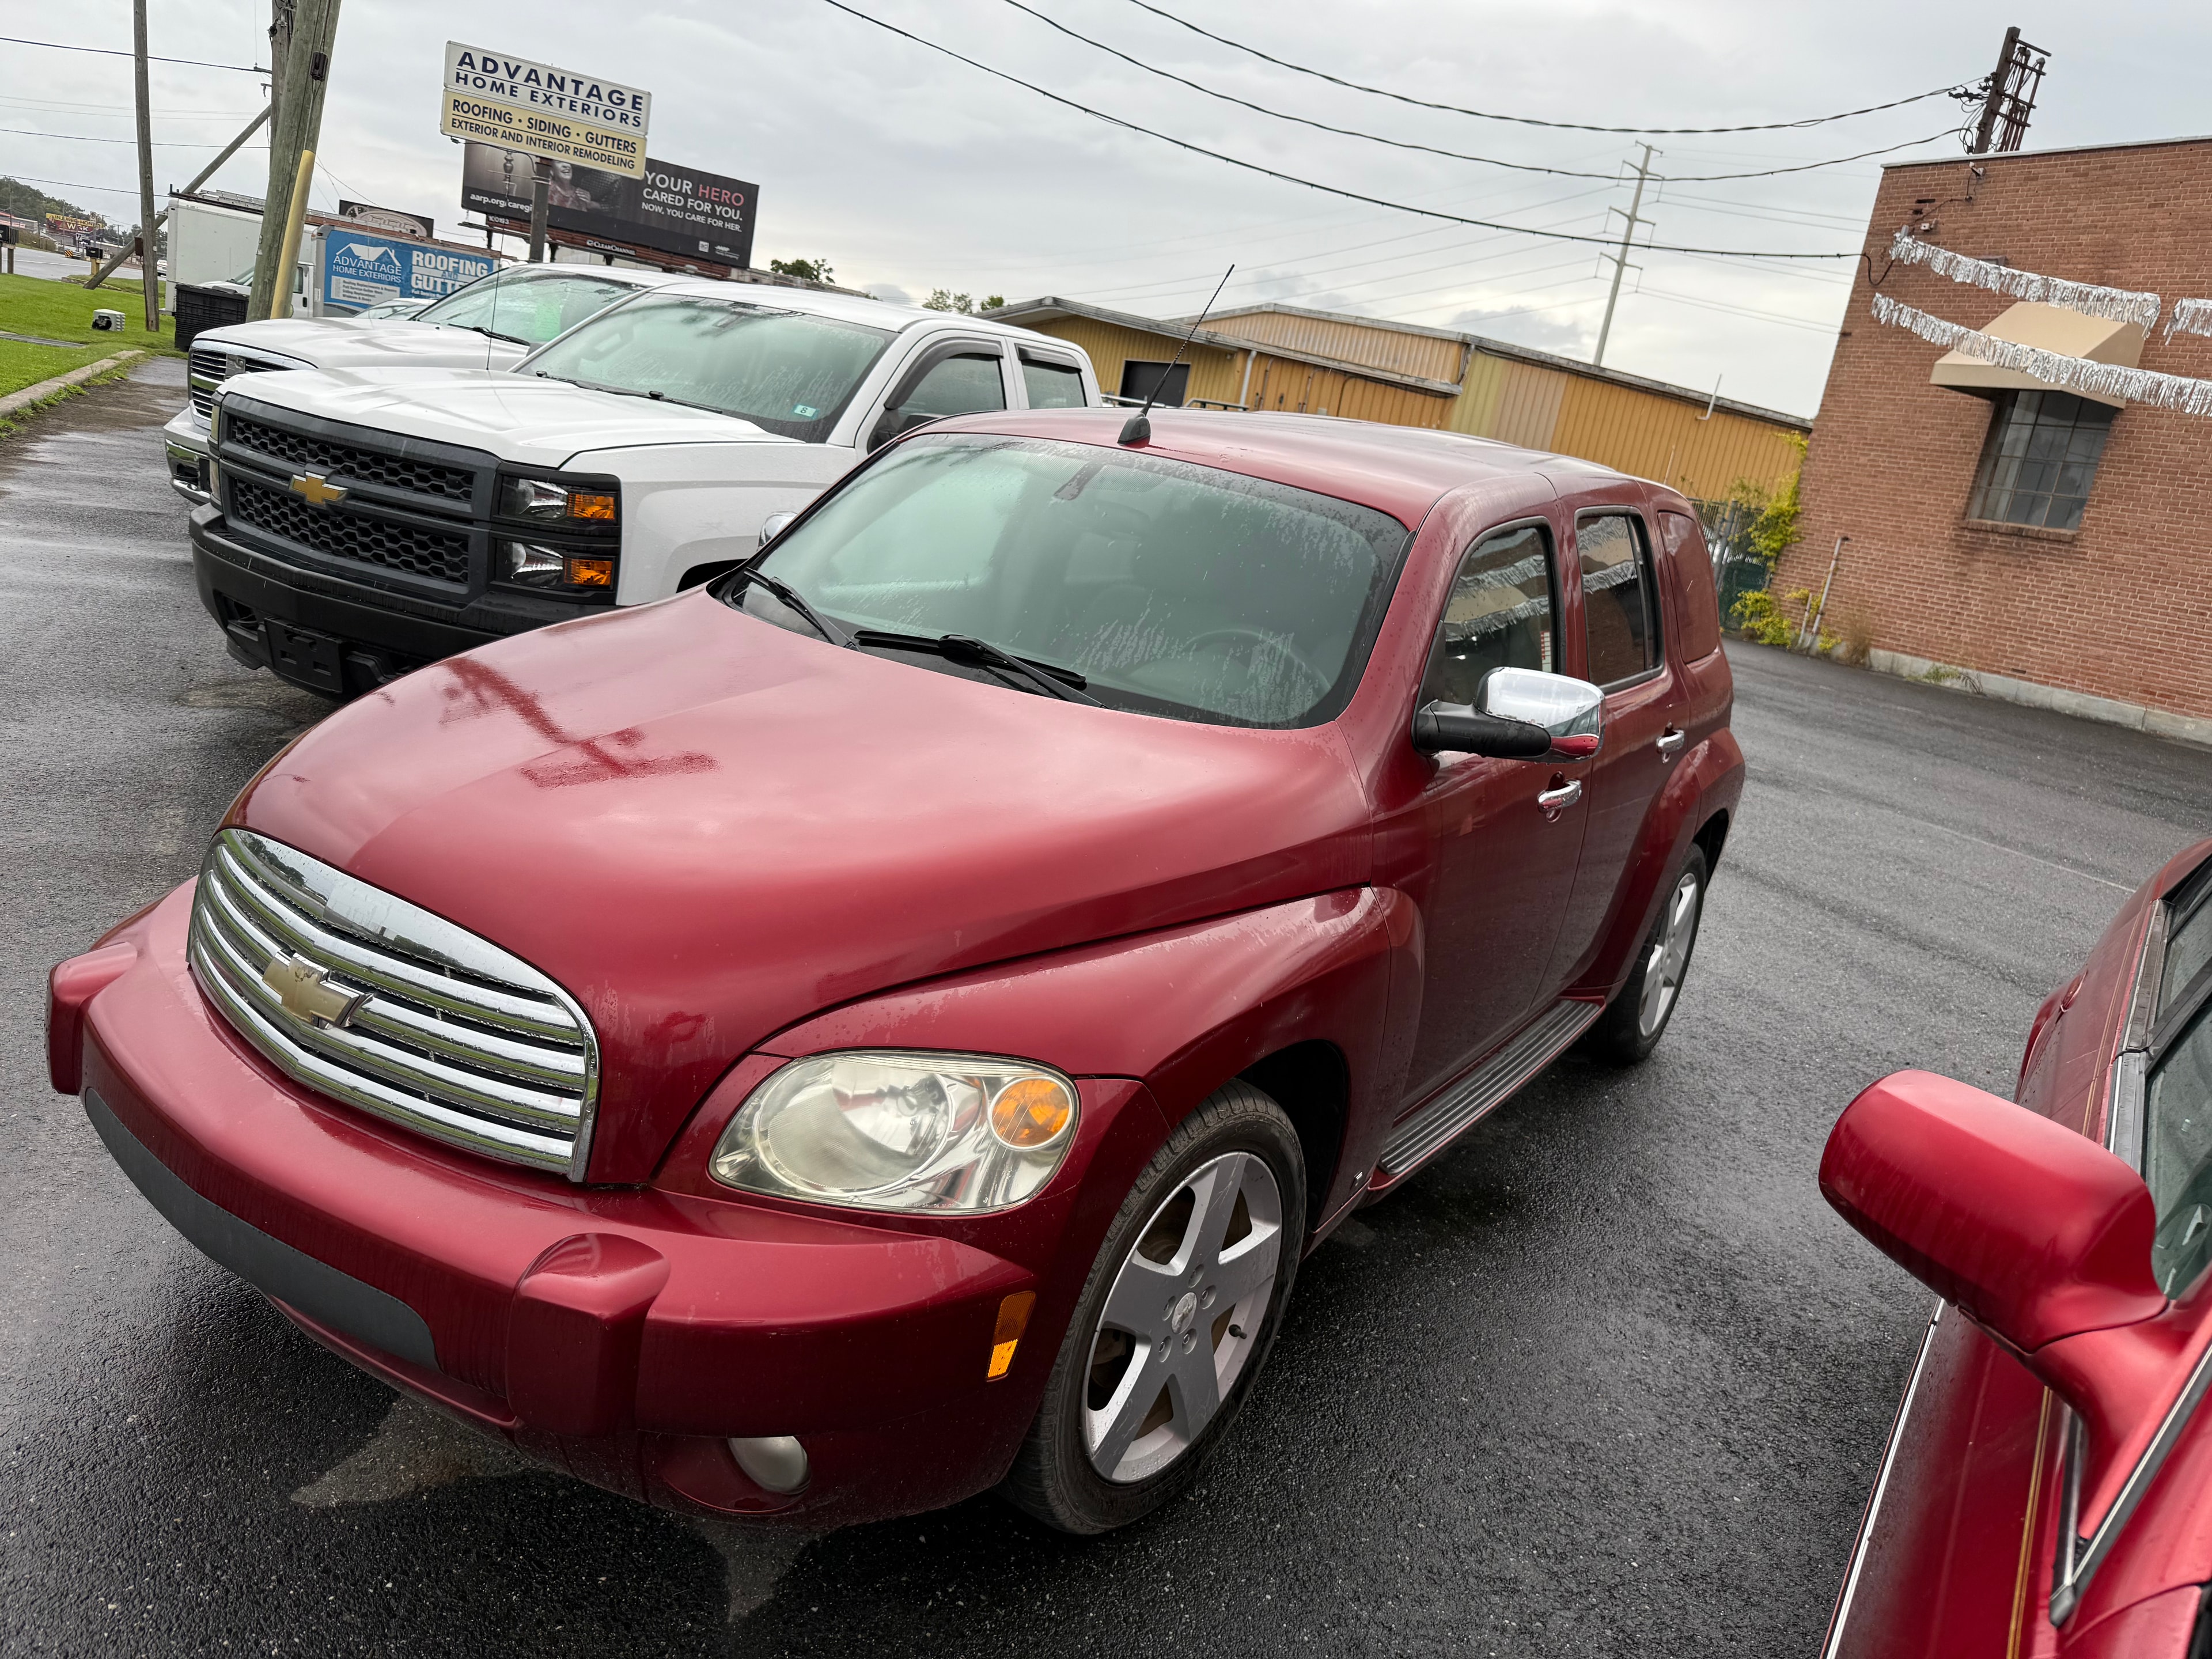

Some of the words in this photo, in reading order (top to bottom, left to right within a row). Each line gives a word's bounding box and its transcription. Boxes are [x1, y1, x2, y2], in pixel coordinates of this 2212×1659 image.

[457, 51, 643, 112] ADVANTAGE
[455, 71, 518, 97] HOME
[530, 87, 642, 127] EXTERIORS
[452, 99, 513, 124] ROOFING
[527, 118, 571, 138] SIDING
[585, 131, 637, 154] GUTTERS
[451, 118, 499, 138] EXTERIOR
[500, 130, 523, 143] AND
[525, 134, 571, 155] INTERIOR
[573, 147, 635, 169] REMODELING
[469, 194, 533, 213] aarp.org/caregi
[643, 188, 685, 207] CARED
[687, 198, 712, 213] FOR
[714, 204, 743, 221] YOU.
[645, 171, 692, 194] YOUR
[698, 184, 745, 207] HERO
[641, 202, 664, 215] NOW,
[666, 207, 684, 219] YOU
[684, 211, 706, 224] CARE
[707, 217, 724, 228] FOR
[724, 221, 743, 232] HER.
[332, 264, 357, 276] HOME
[359, 270, 402, 283] EXTERIORS
[333, 255, 402, 275] ADVANTAGE
[412, 250, 487, 277] ROOFING
[411, 274, 469, 294] GUTTE
